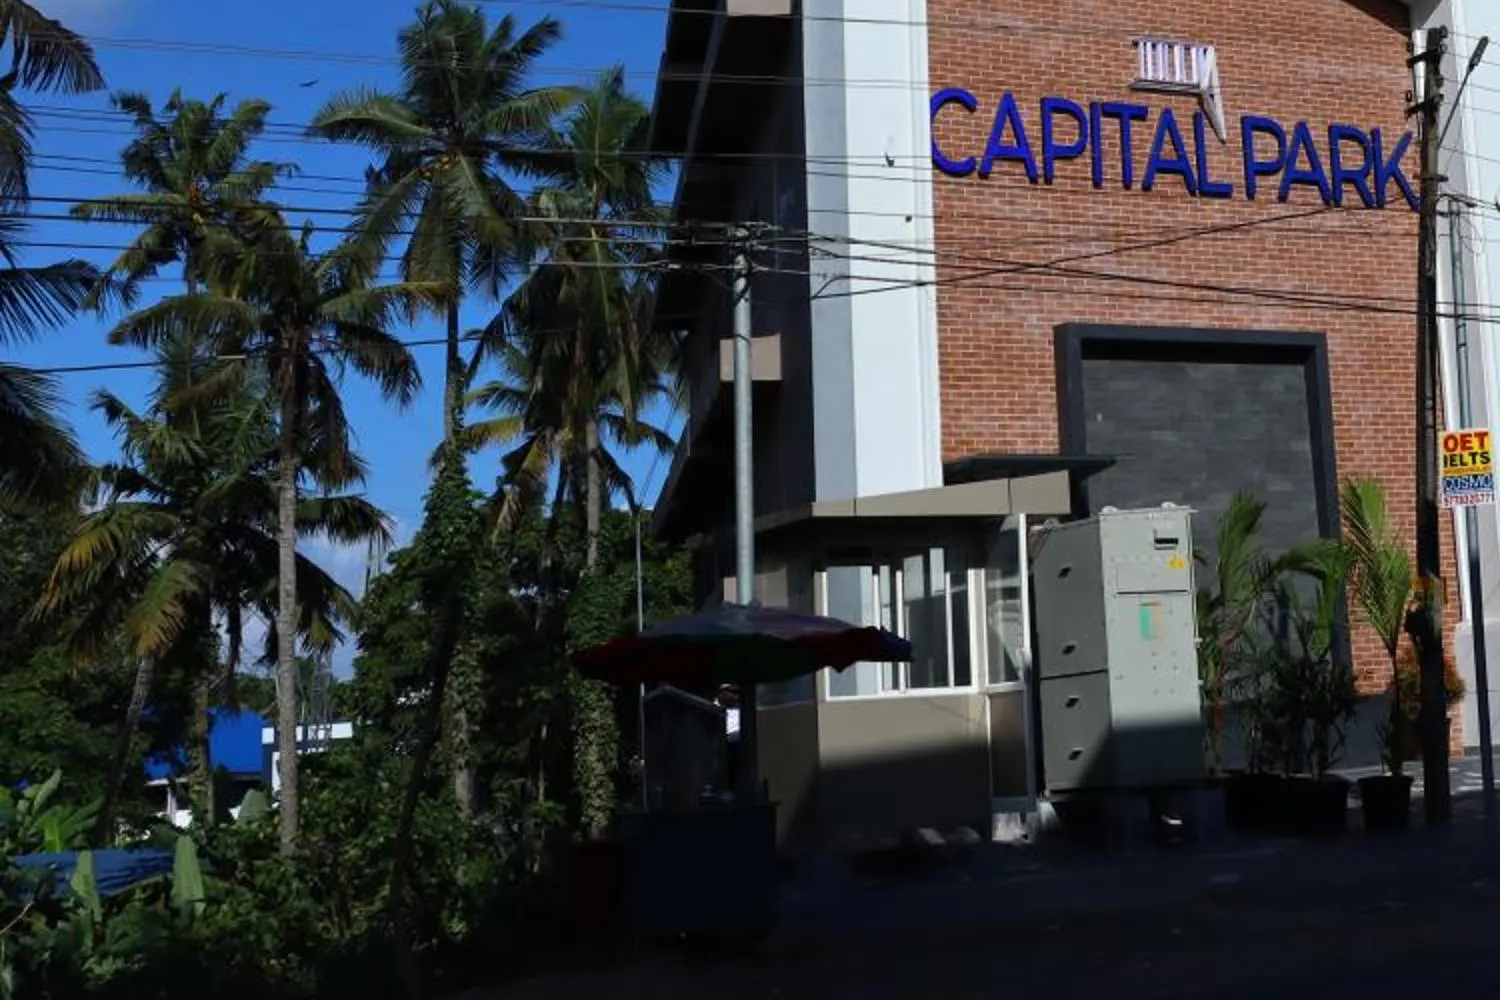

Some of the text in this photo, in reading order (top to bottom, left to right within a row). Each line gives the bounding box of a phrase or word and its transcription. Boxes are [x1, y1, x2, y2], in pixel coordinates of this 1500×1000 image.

[931, 87, 1420, 211] CAPITAL PARK
[1443, 431, 1489, 453] OET
[1443, 452, 1491, 468] IELTS
